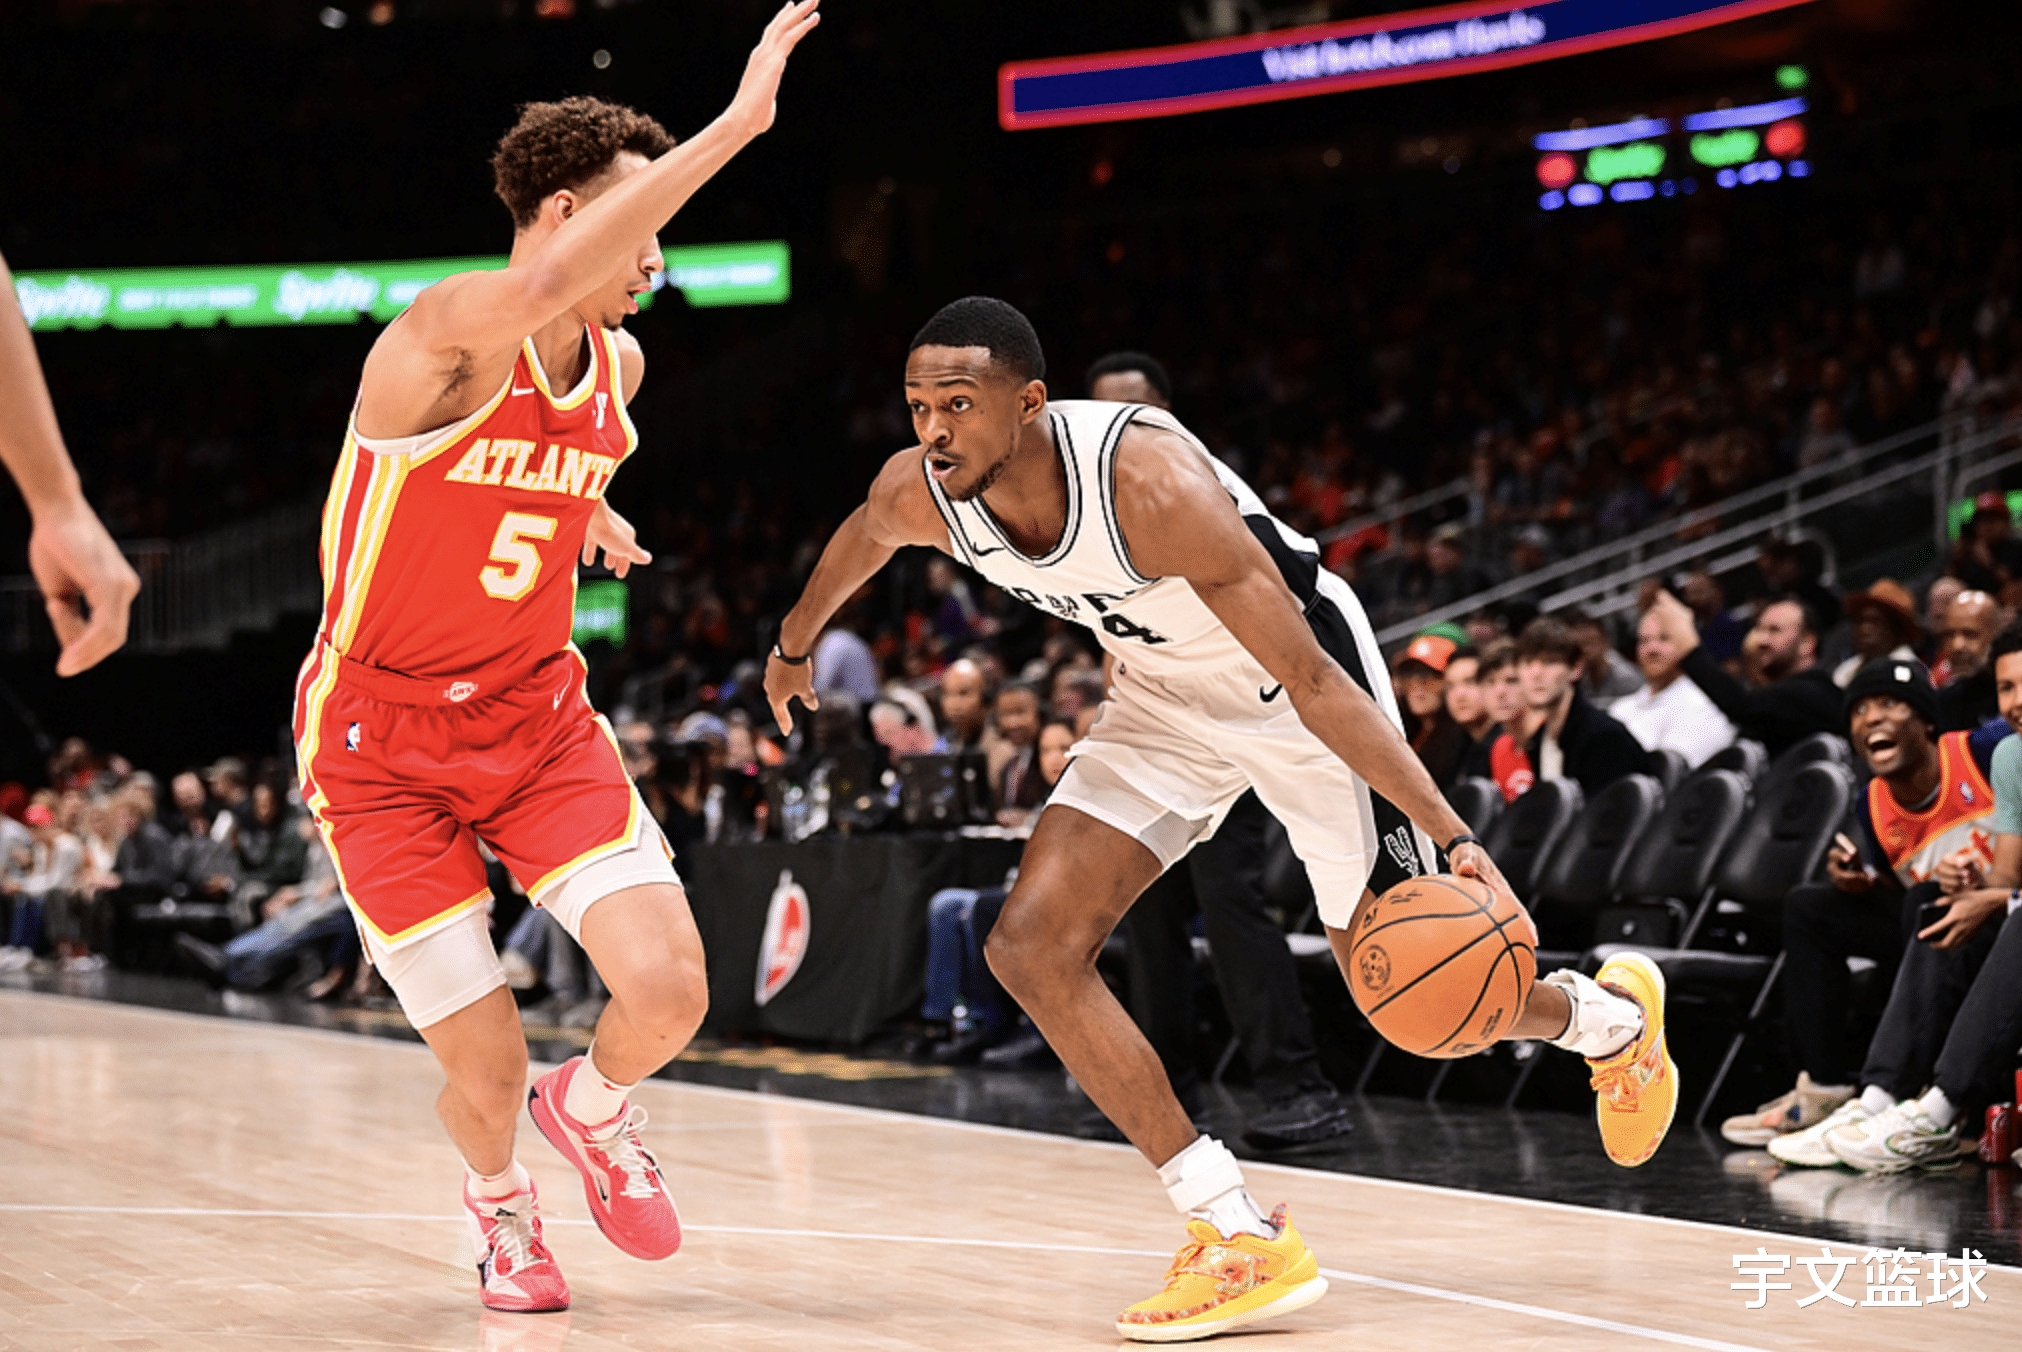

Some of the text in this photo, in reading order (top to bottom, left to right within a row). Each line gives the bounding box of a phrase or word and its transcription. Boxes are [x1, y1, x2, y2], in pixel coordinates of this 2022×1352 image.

[443, 437, 620, 501] ATLANT
[478, 511, 558, 602] 5
[1101, 613, 1173, 646] 4
